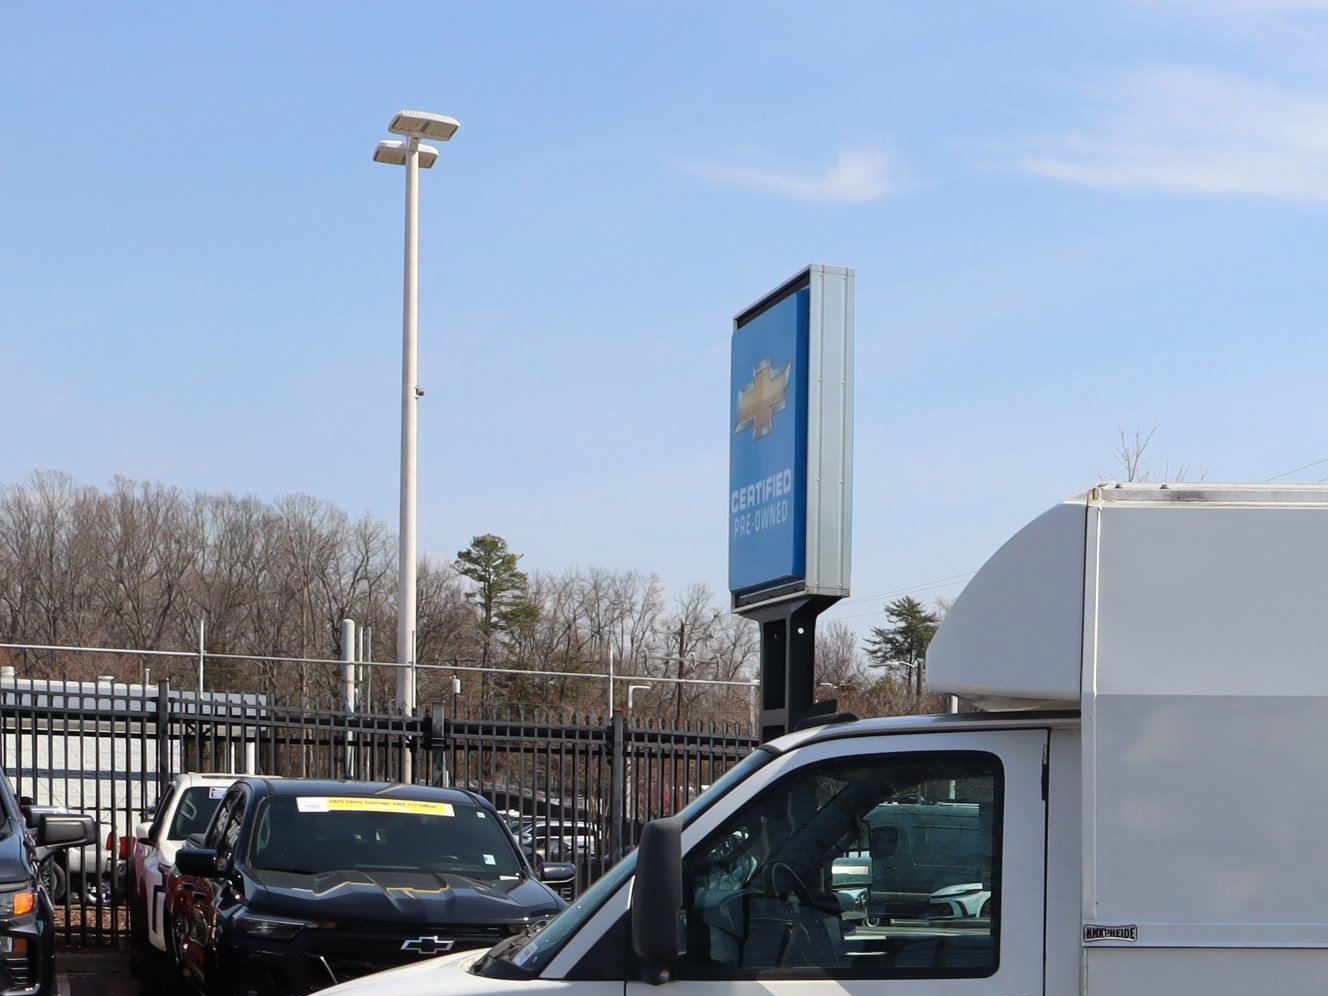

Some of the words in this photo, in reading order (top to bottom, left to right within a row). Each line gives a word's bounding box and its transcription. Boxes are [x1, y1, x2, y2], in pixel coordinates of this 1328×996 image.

[731, 468, 791, 514] CERTIFIED
[734, 499, 788, 539] PRE-OWNED
[1086, 927, 1136, 940] KNAPHEIDE
